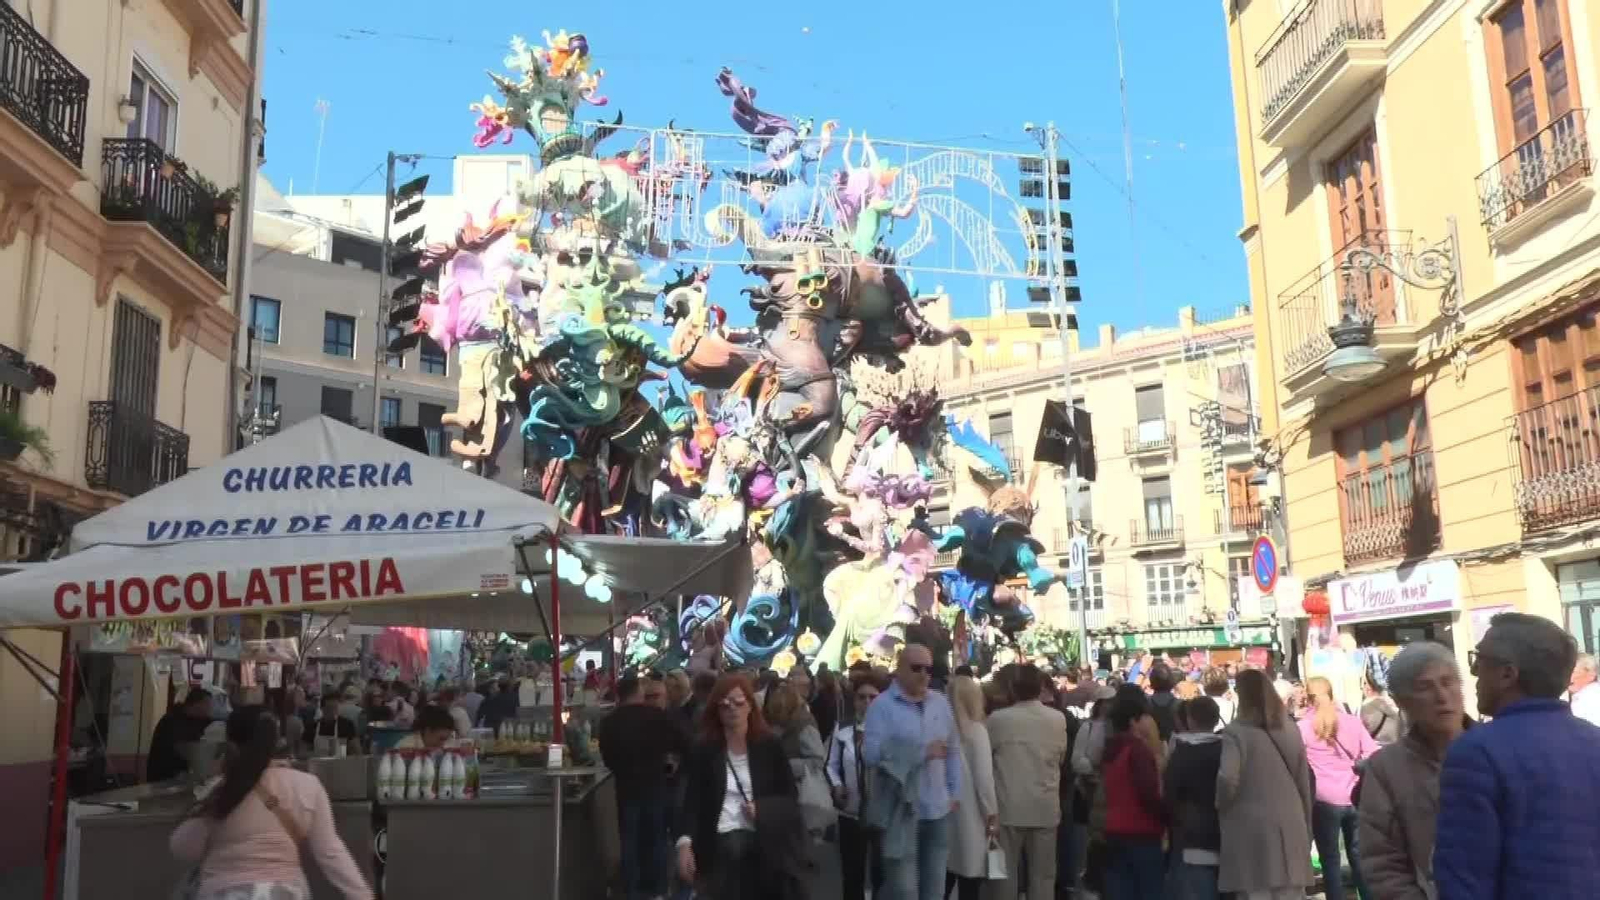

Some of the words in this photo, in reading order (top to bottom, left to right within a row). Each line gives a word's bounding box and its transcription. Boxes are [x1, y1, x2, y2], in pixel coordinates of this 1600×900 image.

[223, 461, 412, 492] CHURRERIA
[147, 516, 277, 541] VIRGEN
[287, 514, 332, 533] DE
[341, 508, 485, 532] ARACELI
[53, 557, 404, 620] CHOCOLATERIA
